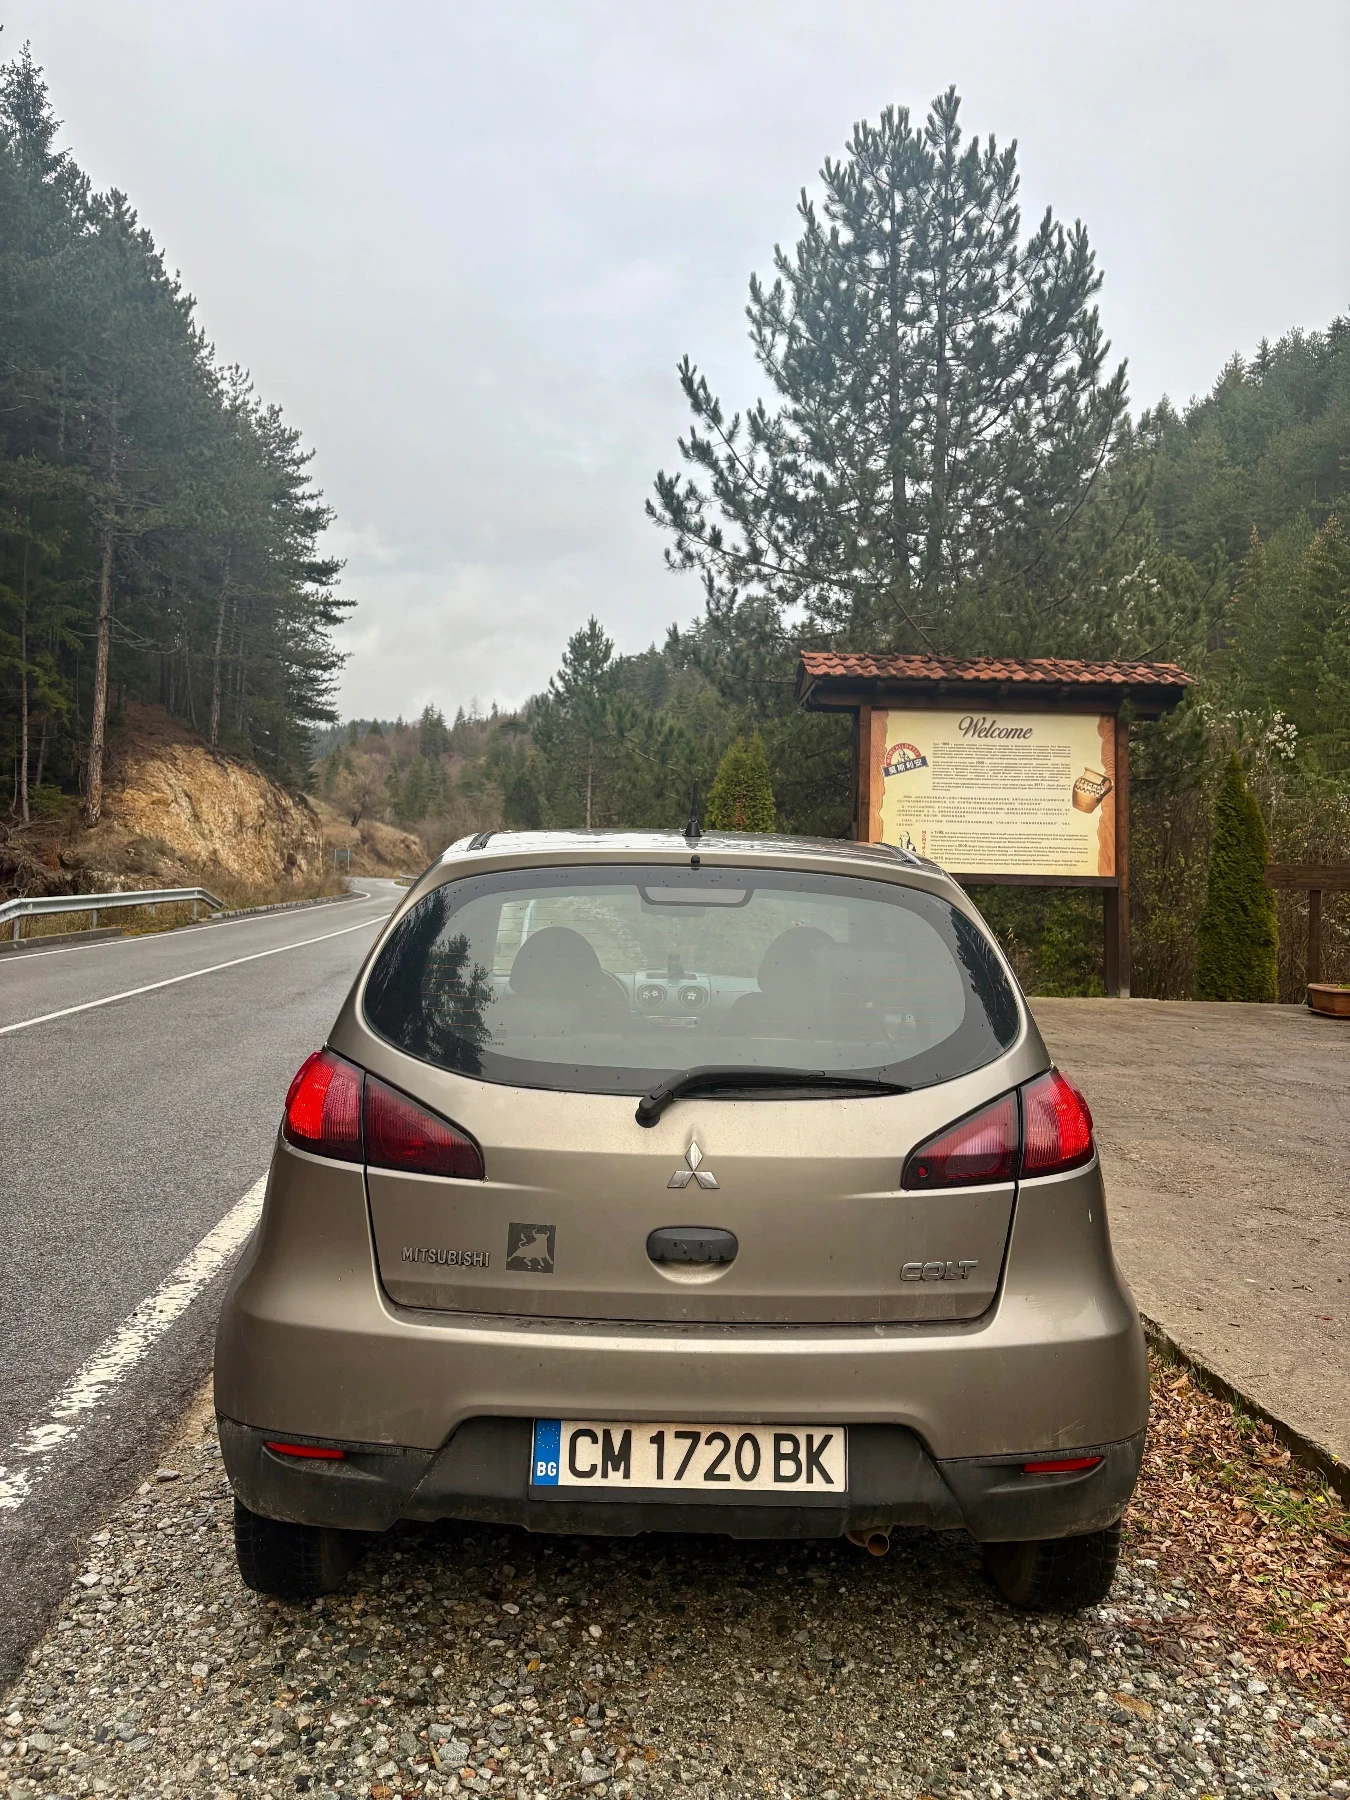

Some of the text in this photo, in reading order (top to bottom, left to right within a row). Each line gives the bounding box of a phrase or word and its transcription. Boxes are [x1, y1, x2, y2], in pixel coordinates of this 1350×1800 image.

[958, 715, 1033, 739] Welcome
[402, 1247, 490, 1267] MITSUBISHI
[900, 1260, 979, 1281] COLT
[568, 1428, 835, 1485] CM 1720 BK
[536, 1461, 557, 1477] BG
